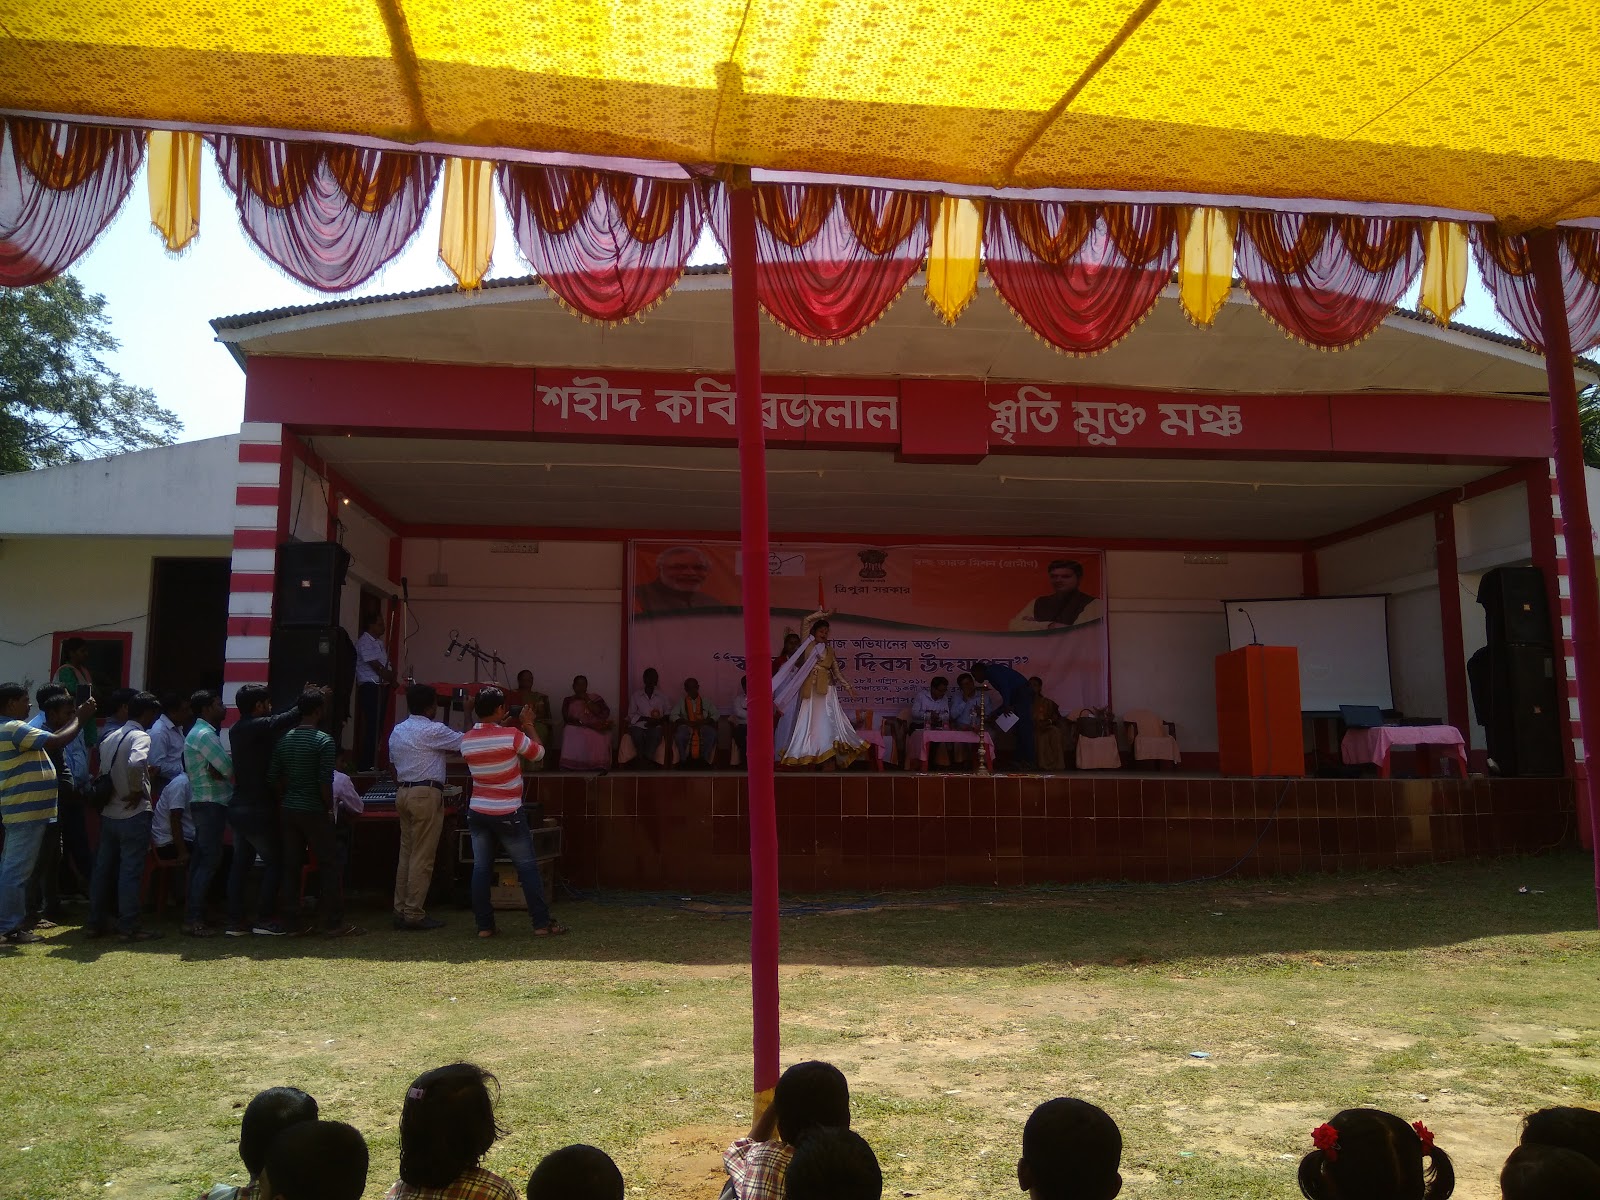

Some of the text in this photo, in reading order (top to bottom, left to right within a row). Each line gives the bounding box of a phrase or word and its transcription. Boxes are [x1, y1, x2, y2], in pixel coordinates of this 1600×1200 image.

[537, 377, 641, 421] শহীদ
[654, 378, 737, 424] কবি
[988, 386, 1061, 444] স্মৃতি
[1071, 401, 1146, 445] মুক্ত
[1158, 403, 1243, 437] মঞ্চ
[834, 584, 910, 595] ত্রিপুরা সরকার
[850, 636, 908, 650] অভিযানের
[911, 637, 951, 650] অন্তর্গত
[854, 652, 913, 672] দিবস
